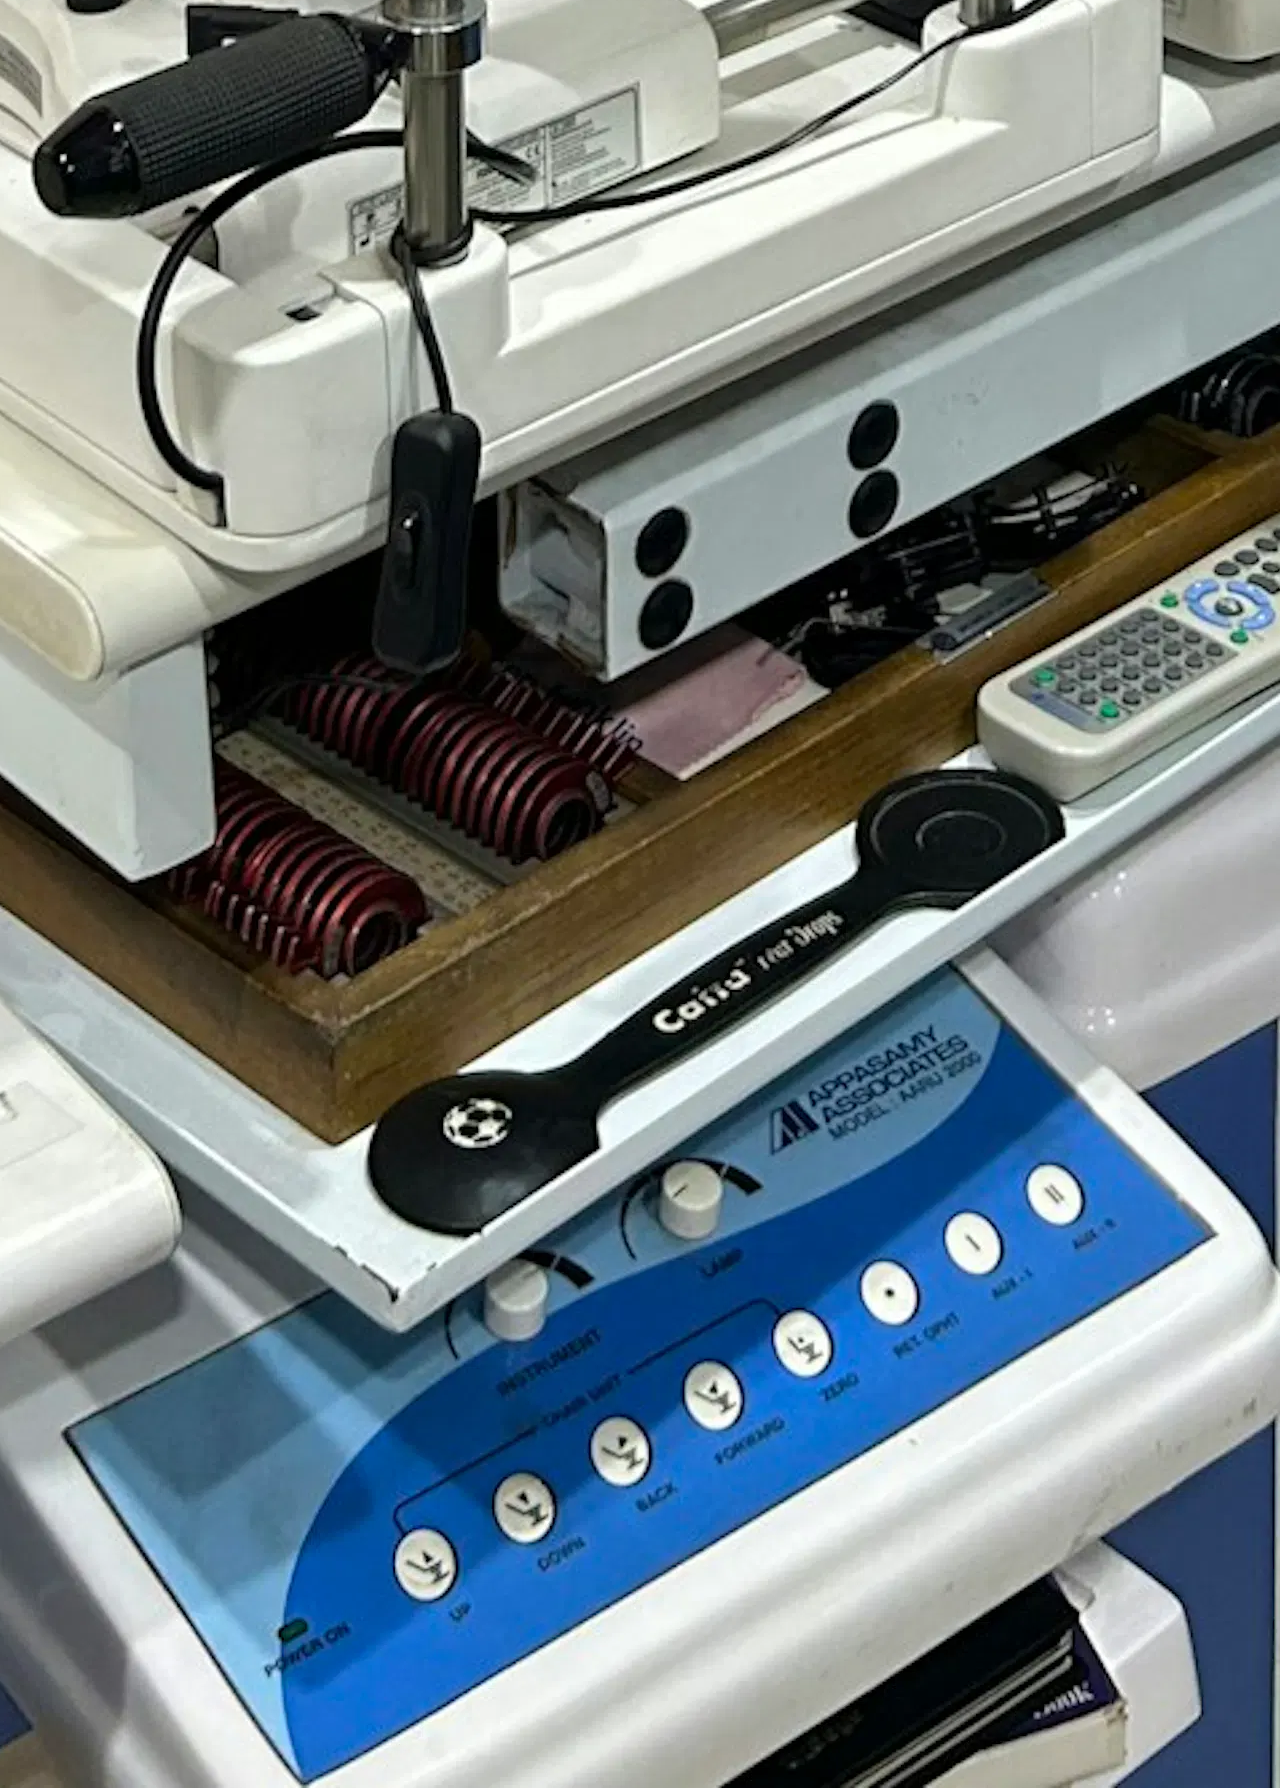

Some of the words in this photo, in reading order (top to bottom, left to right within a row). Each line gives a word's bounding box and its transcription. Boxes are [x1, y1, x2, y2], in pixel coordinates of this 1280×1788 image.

[806, 1024, 940, 1108] APPASAMY
[821, 1034, 969, 1125] ASSOCIATES
[827, 1101, 890, 1141] MODEL
[495, 1327, 602, 1398] INSTRUMENT
[713, 1416, 787, 1466] FORWARD
[634, 1482, 680, 1514] BACK
[536, 1534, 588, 1573] DOWN
[263, 1638, 325, 1678] POWER
[324, 1620, 352, 1650] ON
